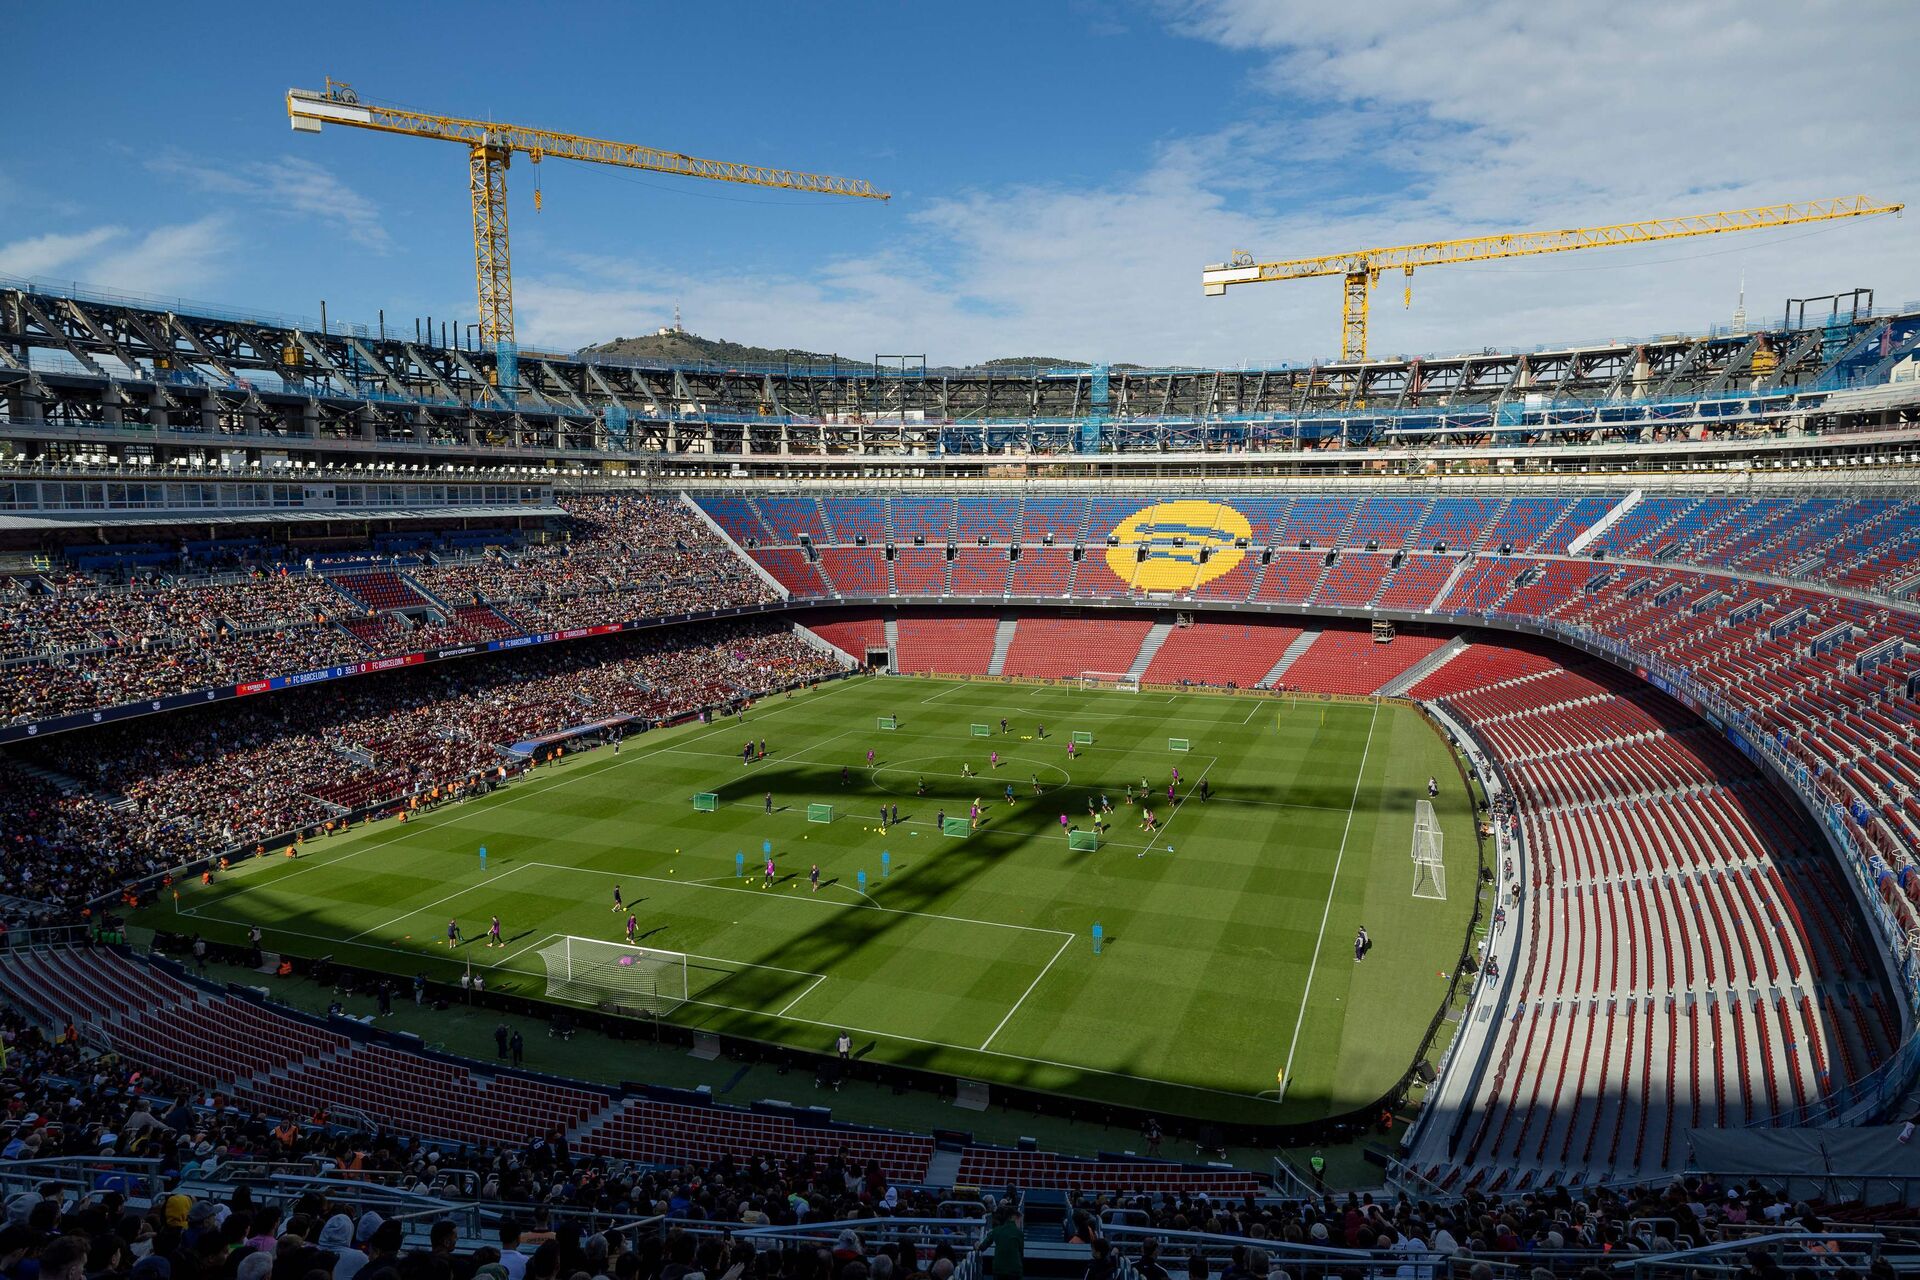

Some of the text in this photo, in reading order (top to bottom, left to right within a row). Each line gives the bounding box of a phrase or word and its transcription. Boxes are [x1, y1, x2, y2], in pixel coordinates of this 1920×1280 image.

[336, 668, 342, 676] 0
[361, 663, 366, 671] 0
[379, 658, 404, 669] BARCELONA
[293, 670, 328, 684] FC BARCELONA
